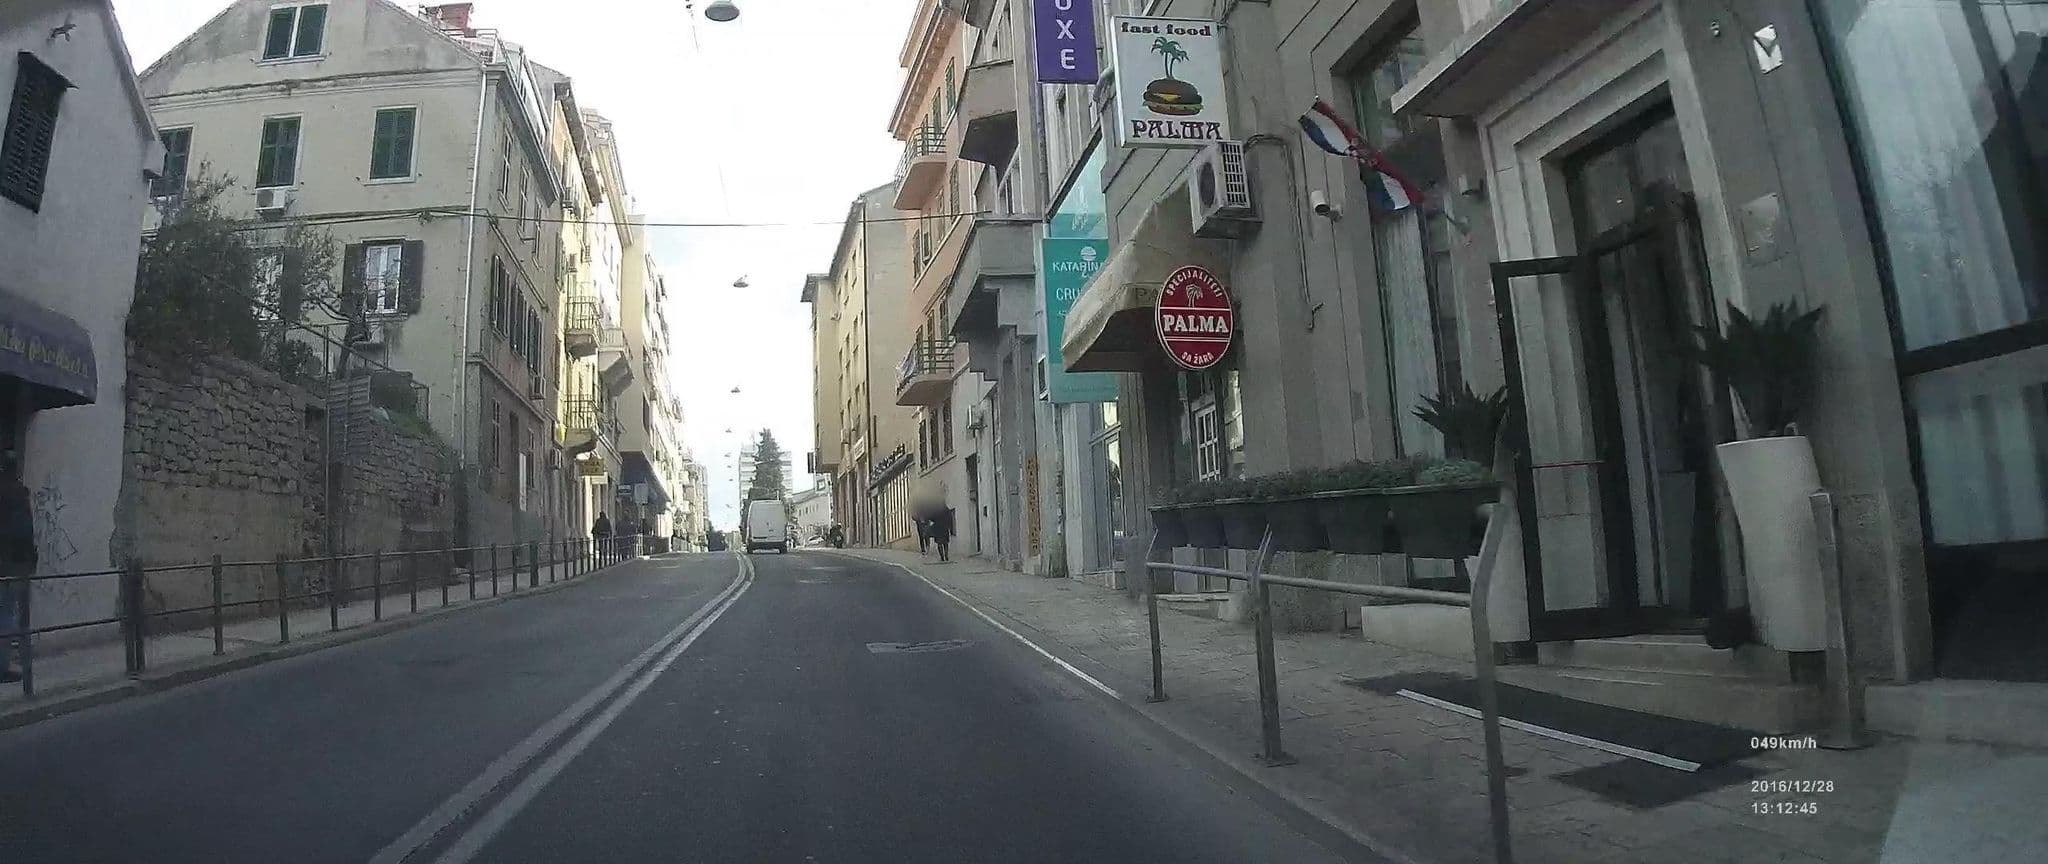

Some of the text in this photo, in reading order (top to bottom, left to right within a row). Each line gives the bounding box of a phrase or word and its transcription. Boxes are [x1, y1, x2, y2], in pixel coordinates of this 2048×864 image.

[1121, 22, 1212, 37] fast food
[1131, 119, 1223, 140] PALMA
[1166, 269, 1223, 298] SPECIJALITETI
[1162, 314, 1229, 333] PALMA
